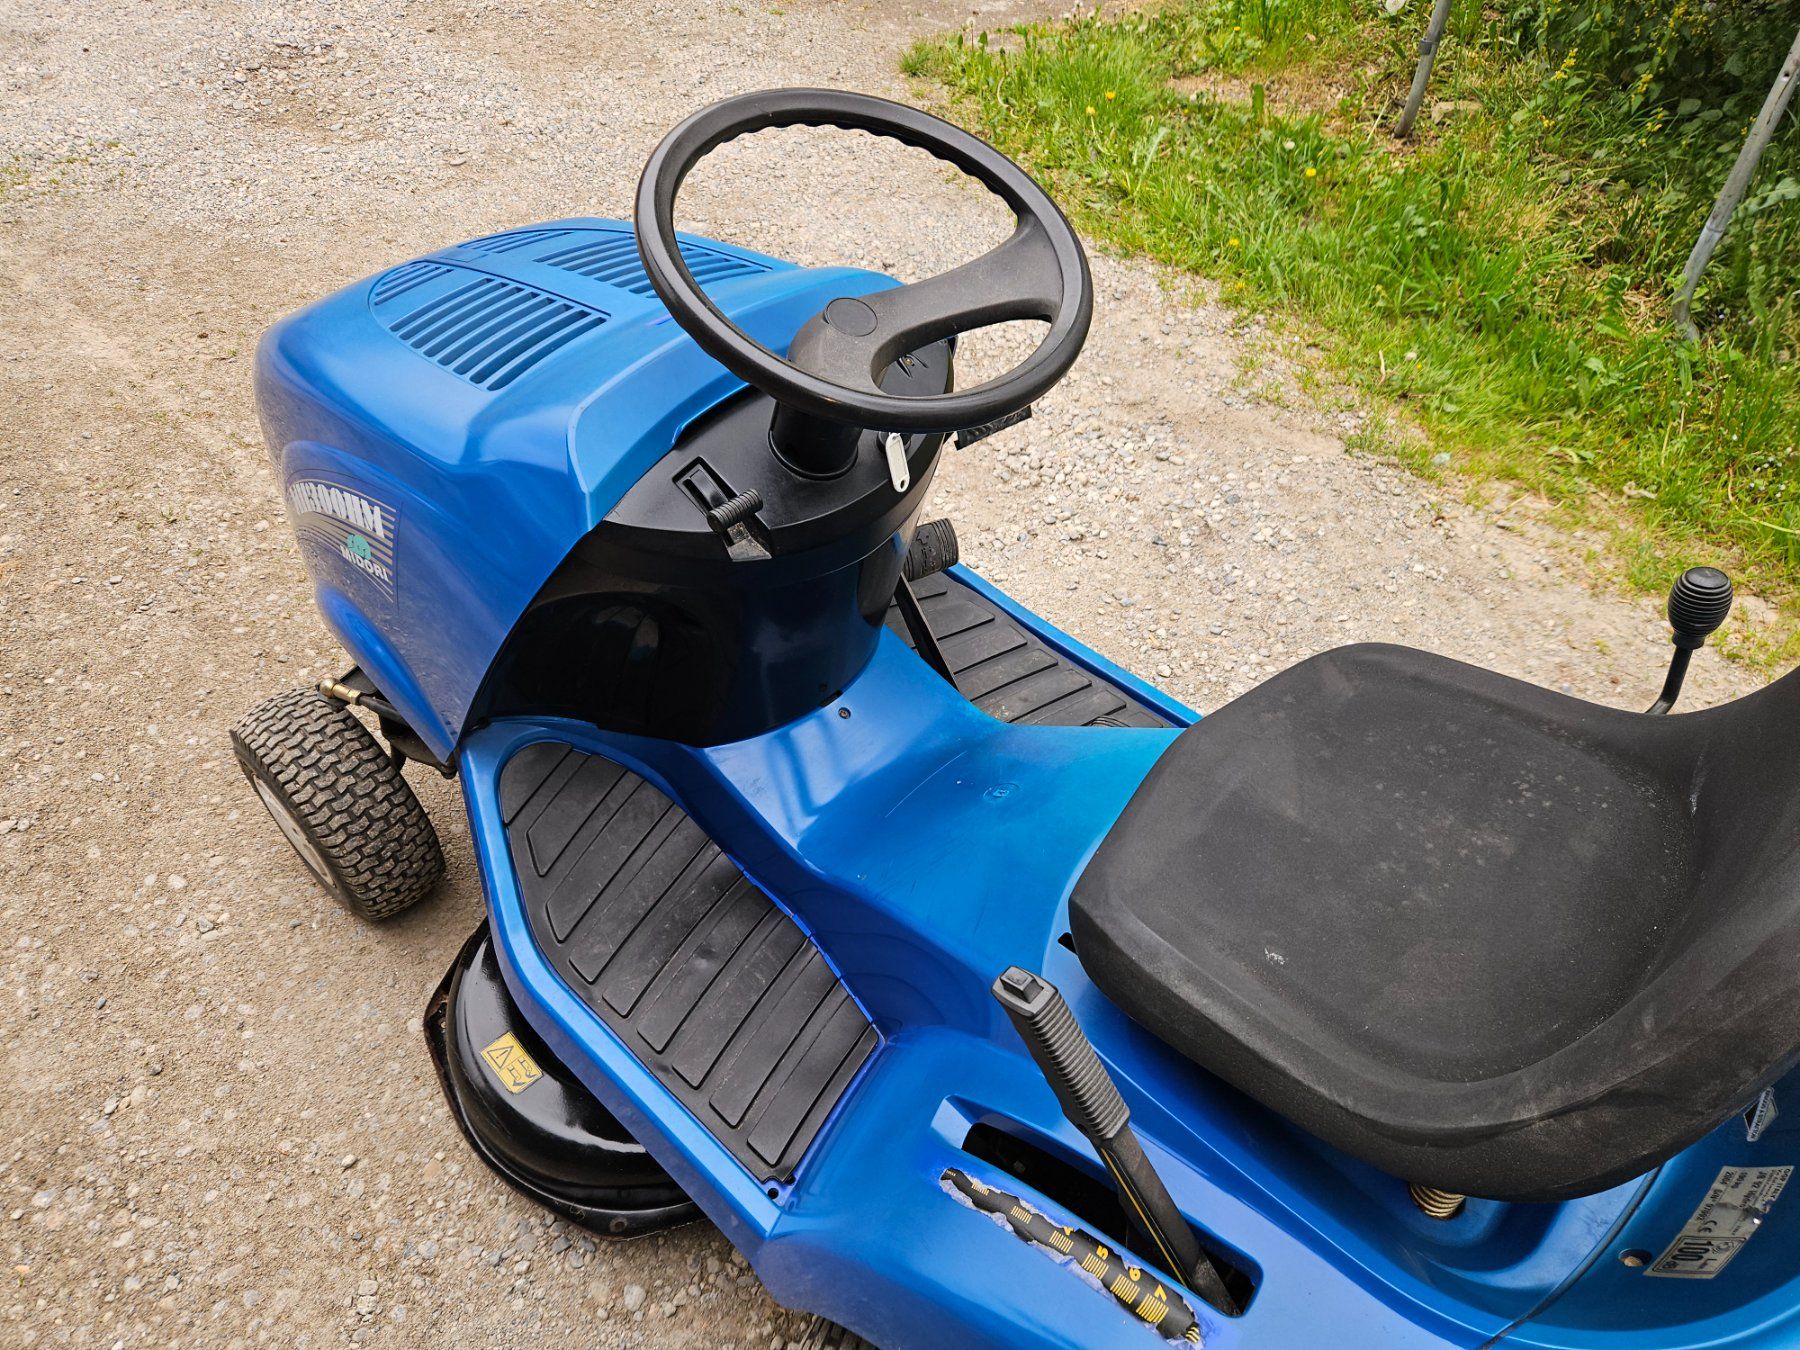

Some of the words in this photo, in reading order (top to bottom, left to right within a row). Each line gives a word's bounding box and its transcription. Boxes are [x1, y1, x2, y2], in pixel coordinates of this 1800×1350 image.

[340, 545, 389, 582] MIDORI
[1671, 1241, 1714, 1261] 100
[1096, 1245, 1109, 1261] 5
[1129, 1267, 1141, 1282] 6
[1153, 1284, 1168, 1302] 7
